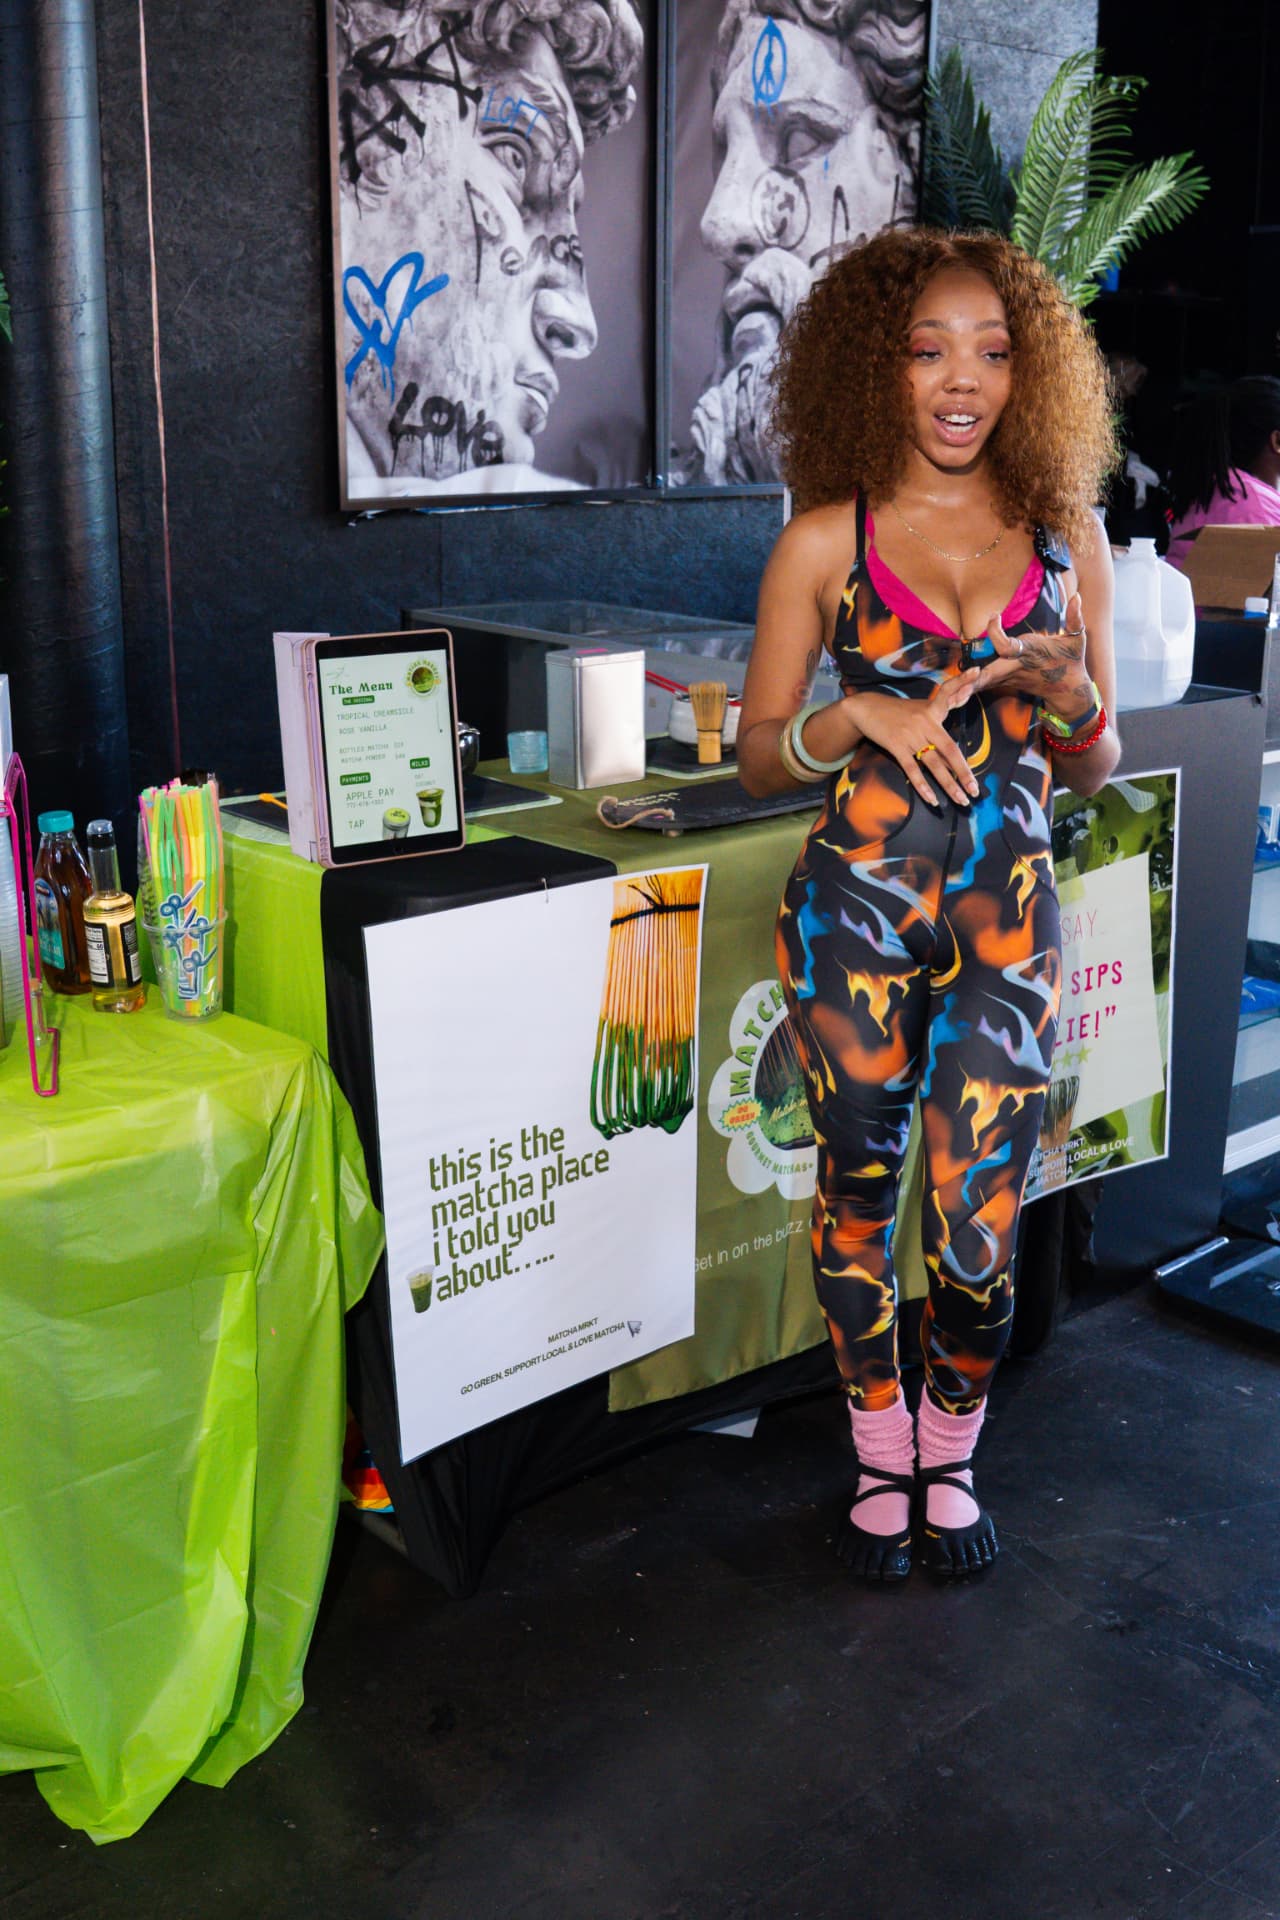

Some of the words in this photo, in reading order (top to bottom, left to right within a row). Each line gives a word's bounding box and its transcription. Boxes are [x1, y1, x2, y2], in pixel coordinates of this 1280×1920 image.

[329, 685, 353, 695] The
[358, 682, 393, 692] Menu
[346, 790, 374, 801] APPLE
[379, 788, 395, 798] PAY
[348, 820, 365, 829] TAP
[1071, 960, 1123, 996] SIPS
[429, 1148, 482, 1192] this
[489, 1138, 513, 1172] is
[521, 1124, 565, 1161] the
[746, 1131, 772, 1169] GOURMET
[1061, 1138, 1085, 1151] MRKT
[1069, 1147, 1099, 1163] LOCAL
[1101, 1143, 1108, 1152] &
[1109, 1136, 1135, 1151] LOVE
[432, 1171, 534, 1230] matcha
[542, 1149, 609, 1201] place
[433, 1232, 441, 1266] i
[448, 1210, 499, 1259] told
[507, 1200, 555, 1248] you
[732, 1243, 749, 1258] on
[753, 1230, 773, 1249] the
[775, 1219, 804, 1242] buzz
[548, 1326, 578, 1344] MATCHA
[578, 1317, 599, 1332] MRKT
[460, 1383, 473, 1395] GO
[474, 1371, 504, 1390] GREEN,
[504, 1356, 542, 1377] SUPPORT
[542, 1346, 567, 1362] LOCAL
[573, 1334, 594, 1348] LOVE
[594, 1321, 626, 1340] MATCHA
